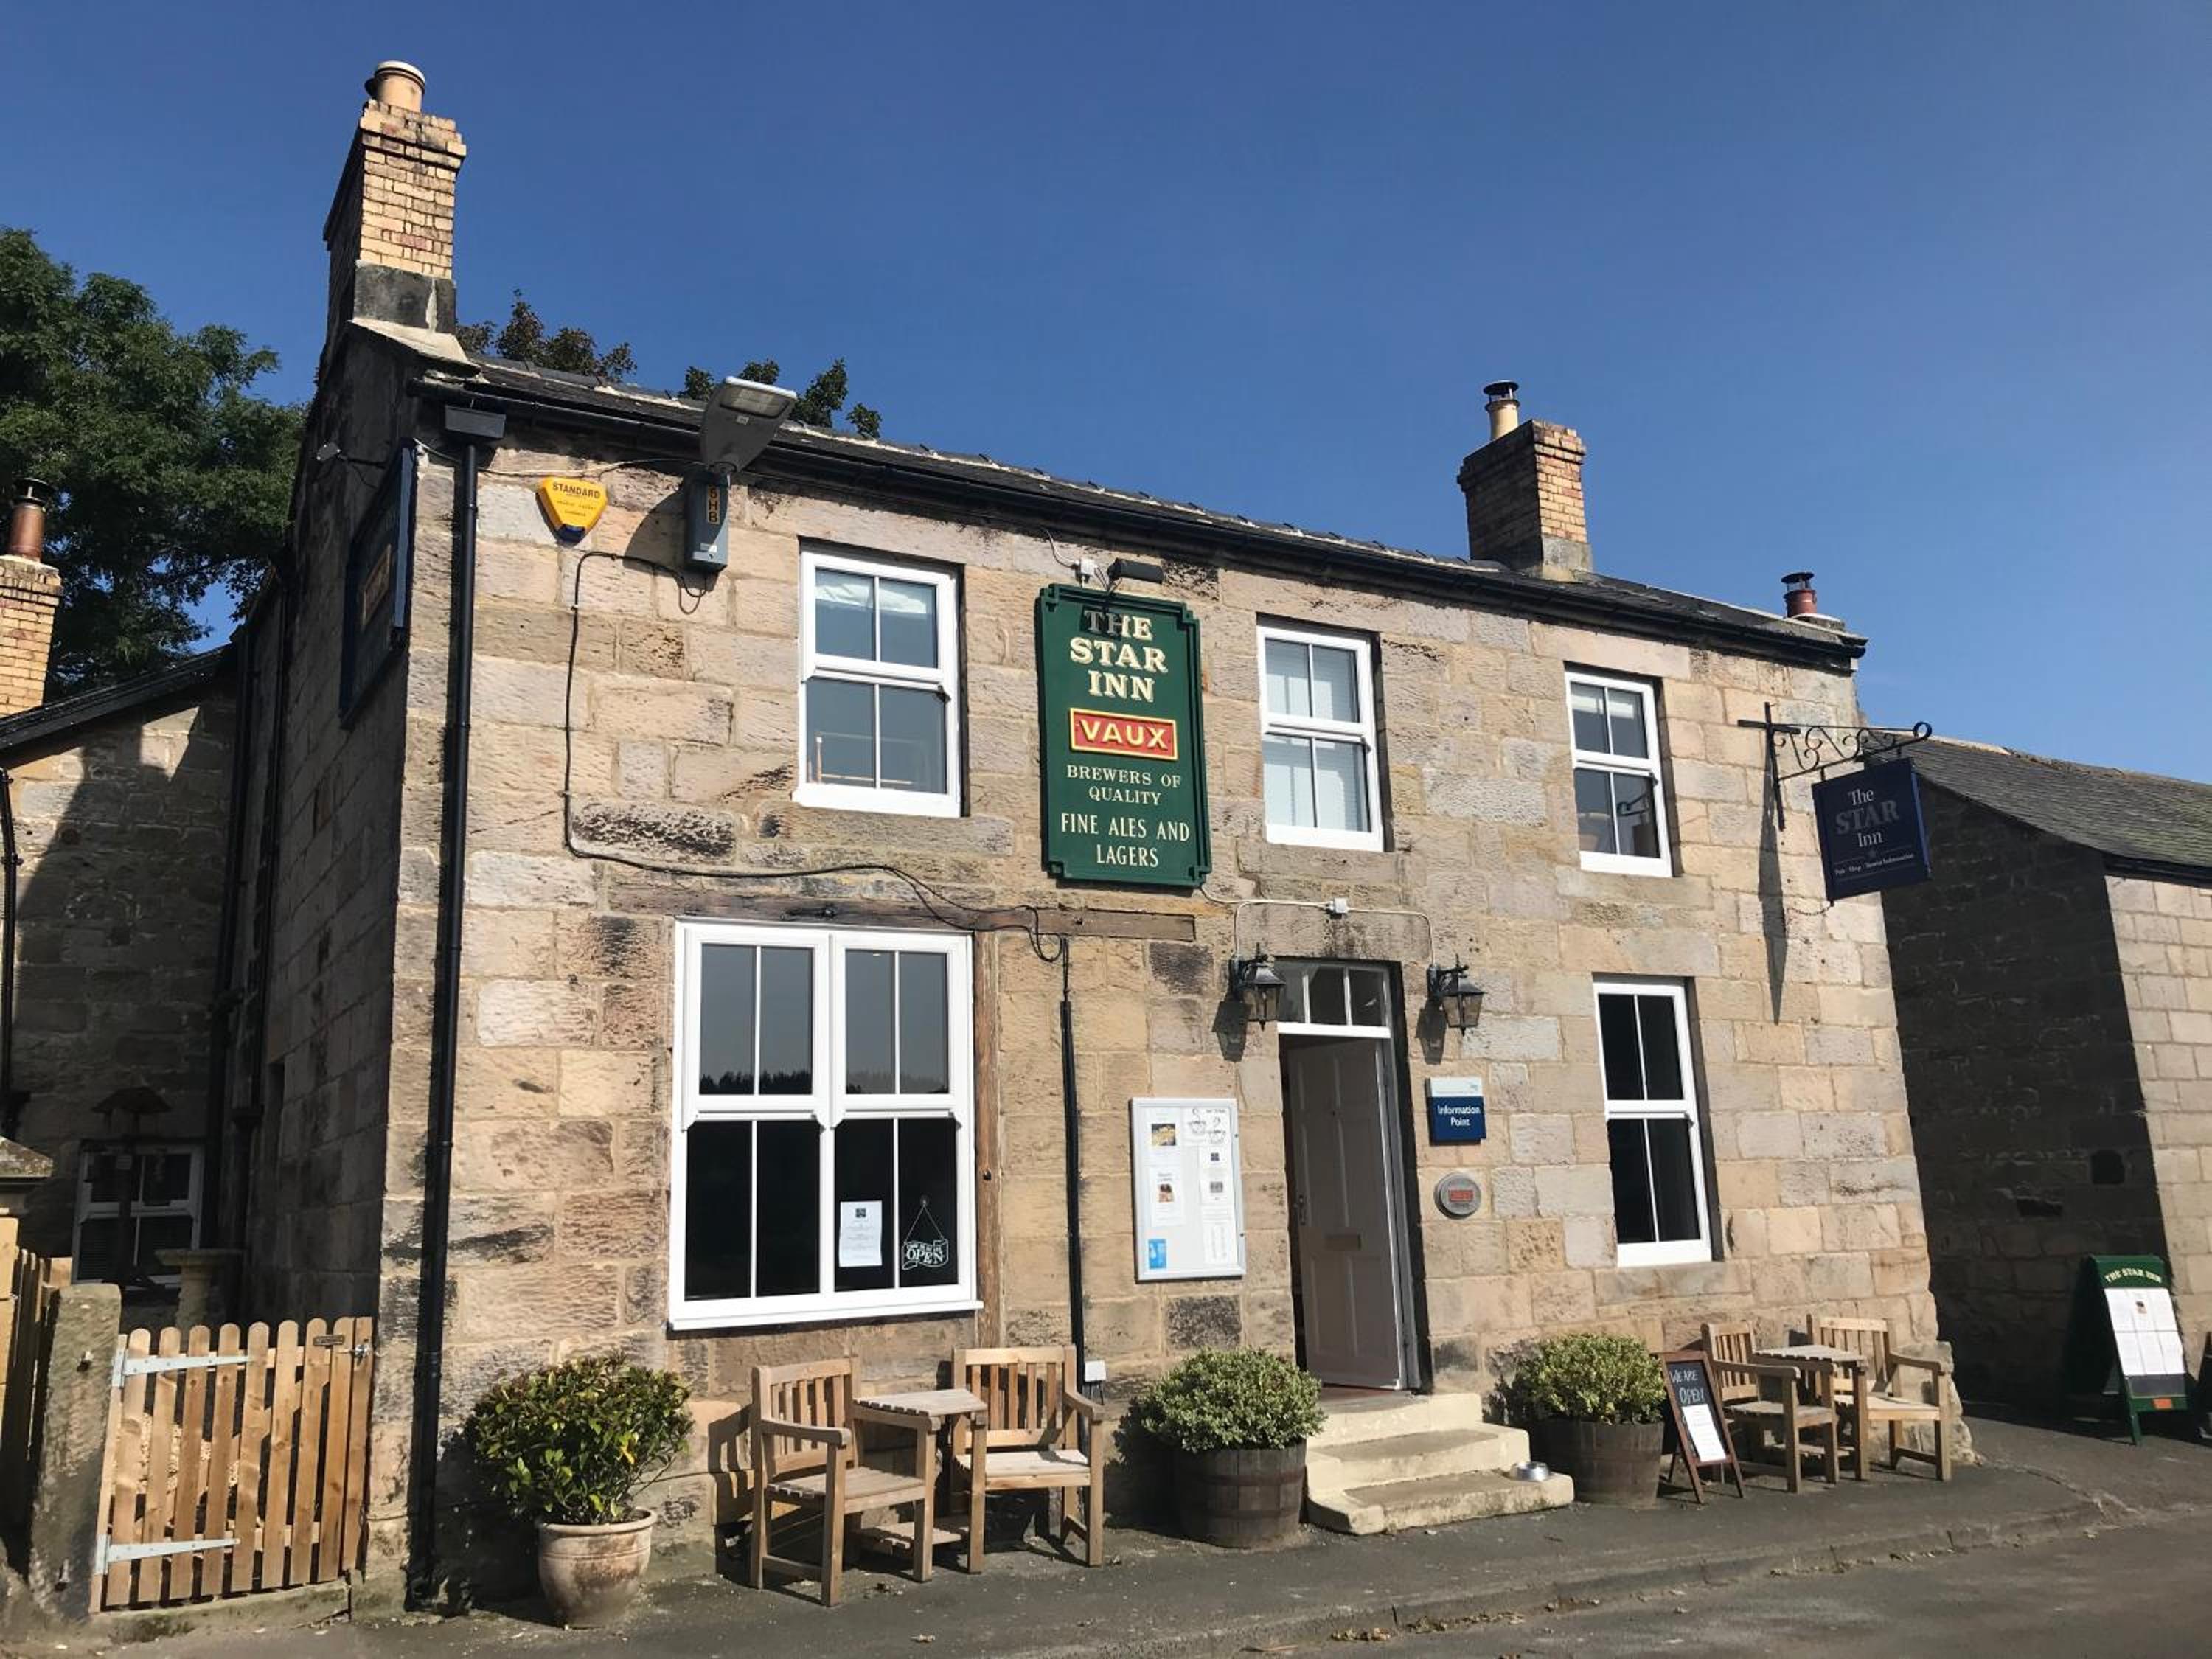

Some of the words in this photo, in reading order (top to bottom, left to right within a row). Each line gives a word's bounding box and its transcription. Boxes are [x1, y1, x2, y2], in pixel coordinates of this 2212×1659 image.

[552, 481, 601, 499] STANDARD
[1084, 609, 1152, 641] THE
[1070, 637, 1168, 673] STAR
[1088, 669, 1154, 702] INN
[1079, 718, 1168, 750] VAUX
[1067, 765, 1152, 785] BREWERS
[1161, 773, 1181, 787] OF
[1088, 787, 1161, 806] QUALITY
[1847, 788, 1874, 806] The
[1061, 813, 1099, 835] FINE
[1108, 818, 1147, 839] ALES
[1156, 821, 1190, 841] AND
[1834, 800, 1899, 835] STAR
[1857, 831, 1884, 847] Inn
[1096, 844, 1159, 867] LAGERS
[1437, 1105, 1481, 1116] Information
[1450, 1116, 1470, 1127] Point
[906, 1248, 945, 1265] OPEN
